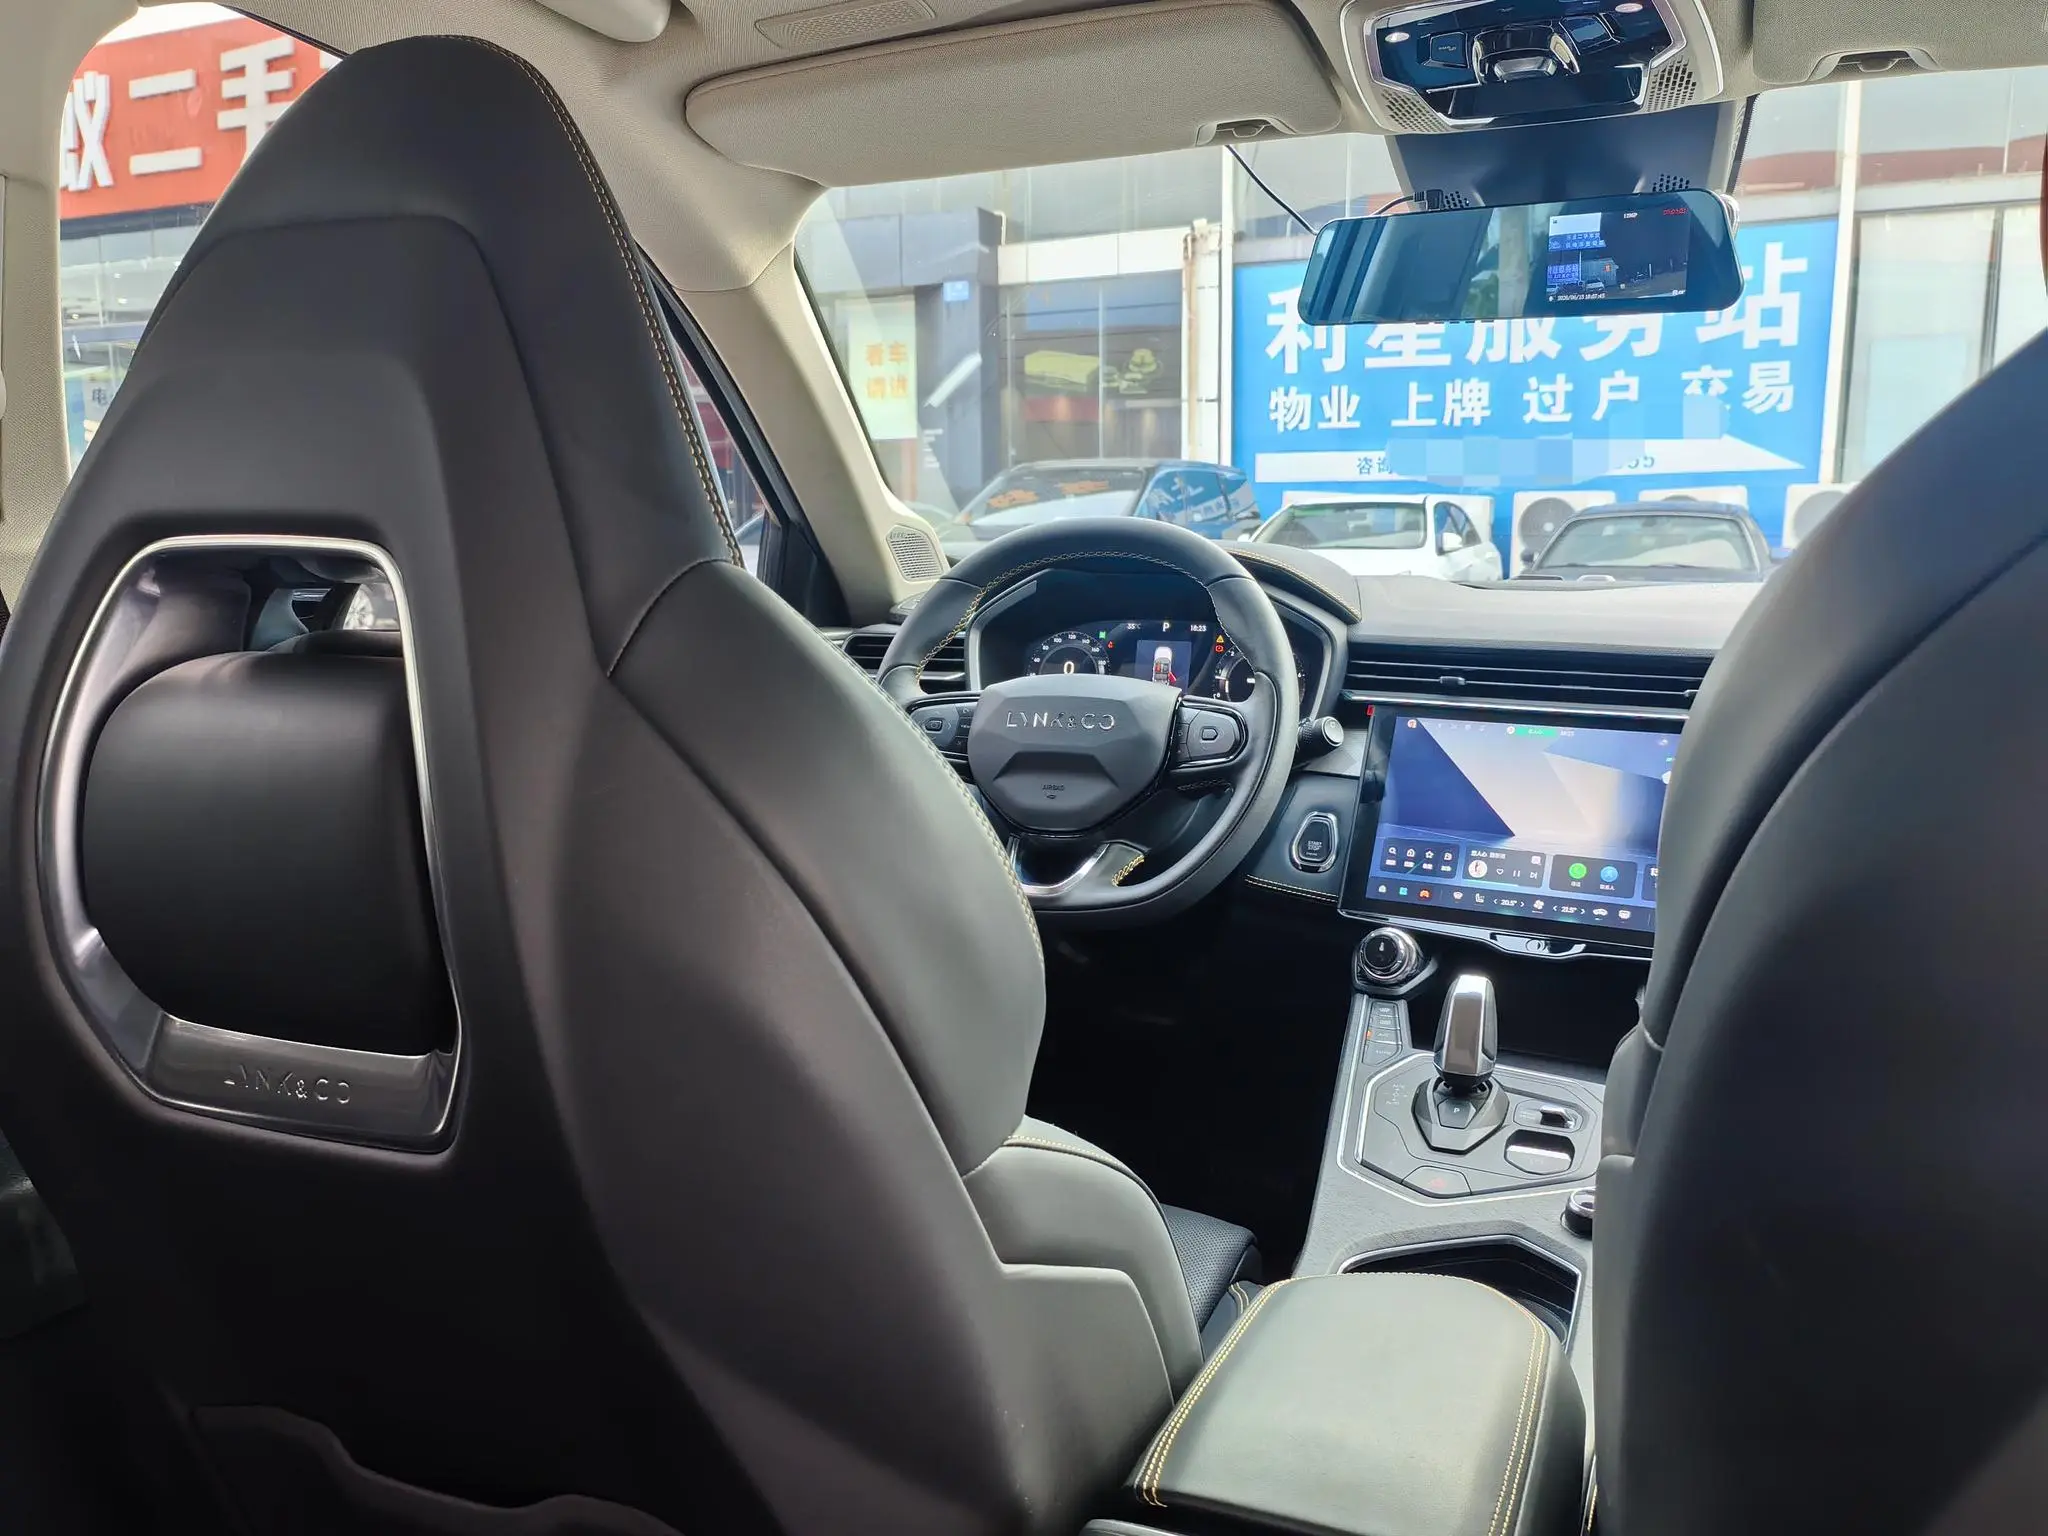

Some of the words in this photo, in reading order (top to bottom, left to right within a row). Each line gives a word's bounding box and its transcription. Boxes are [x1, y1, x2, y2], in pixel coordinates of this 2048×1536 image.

[60, 35, 342, 192] 蚁二手
[1269, 384, 1360, 432] 物业
[1391, 377, 1492, 426] 上牌
[1522, 369, 1640, 424] 过户
[1681, 360, 1795, 415] 交易
[1162, 622, 1170, 632] P
[1190, 624, 1207, 632] 18:23
[1063, 661, 1075, 675] 0
